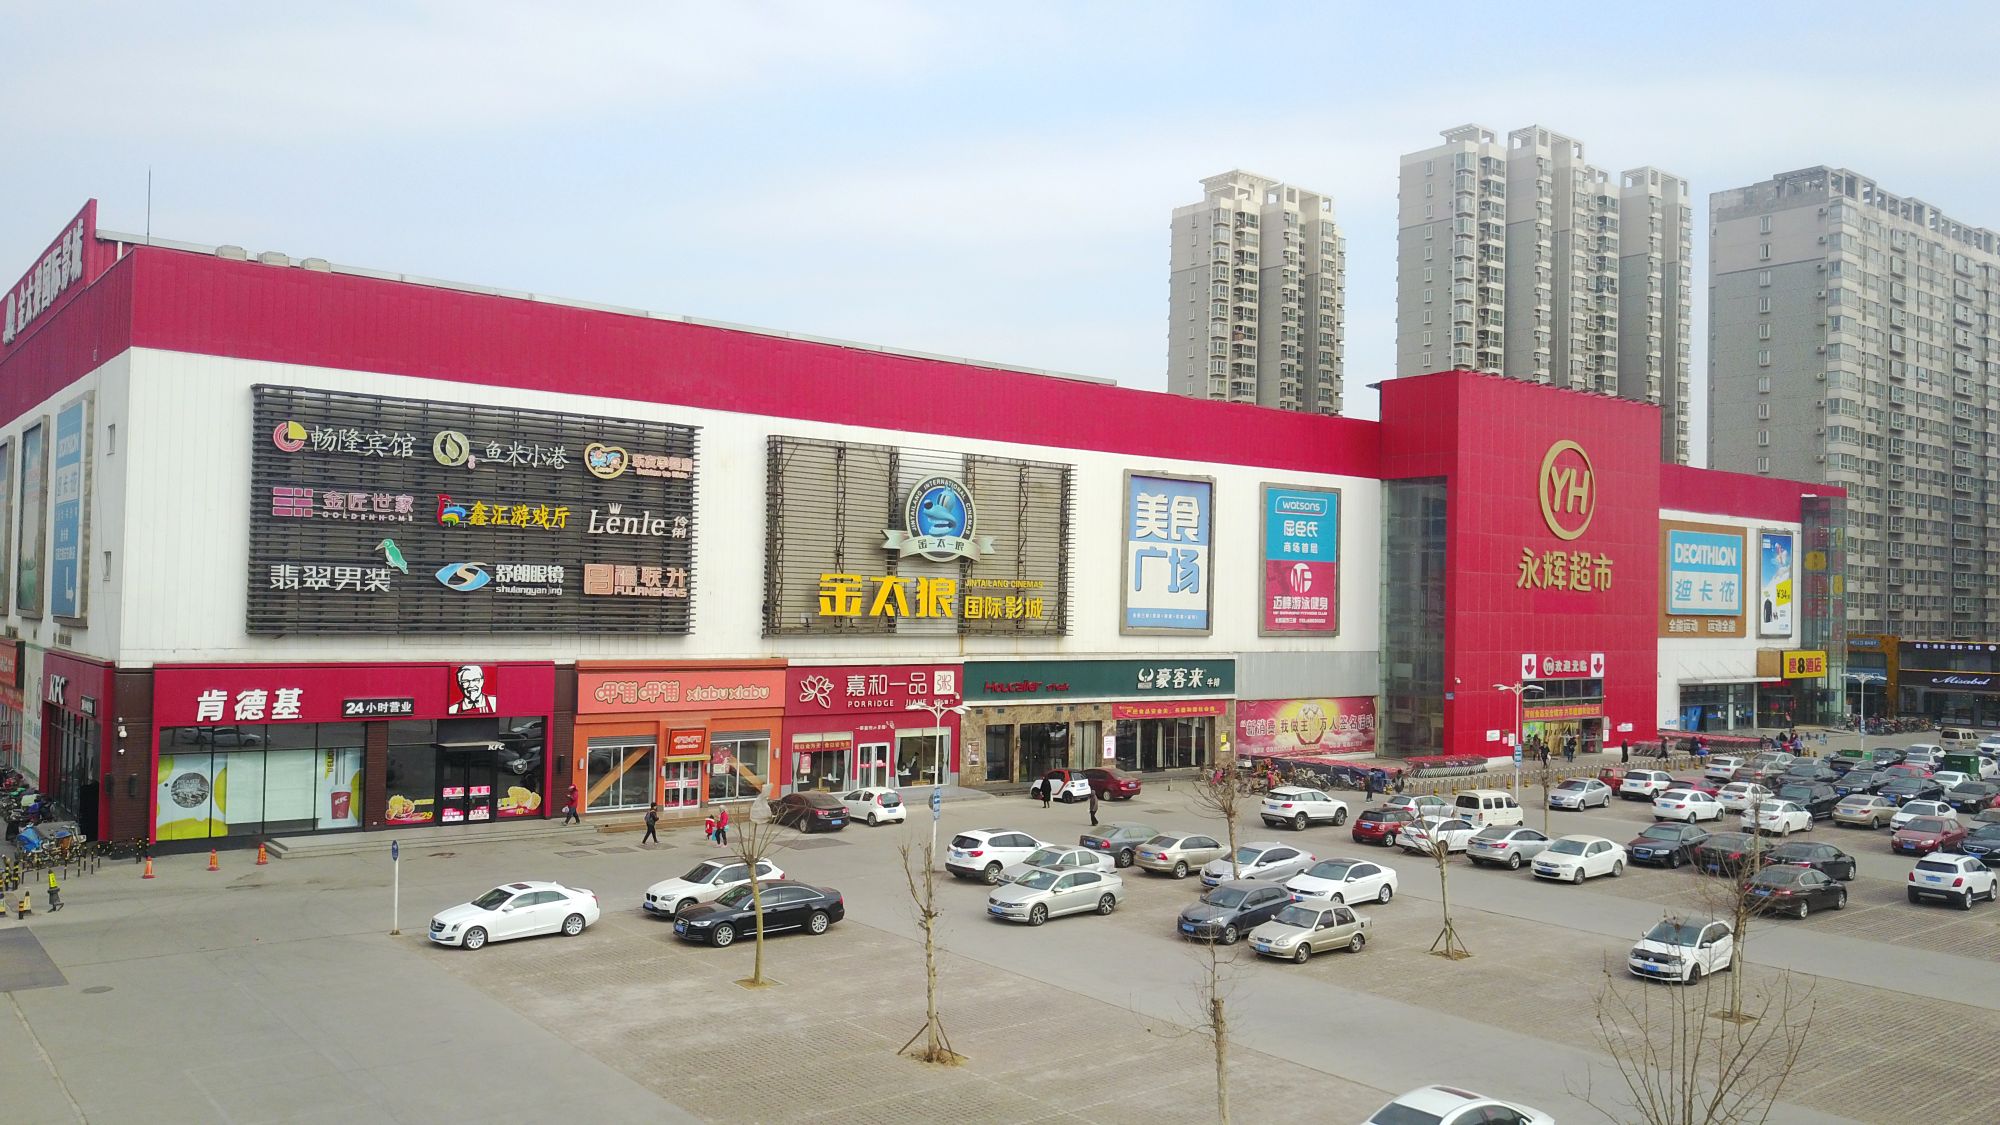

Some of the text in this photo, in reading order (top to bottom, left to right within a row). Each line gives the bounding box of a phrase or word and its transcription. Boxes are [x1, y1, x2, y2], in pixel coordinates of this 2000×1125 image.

[311, 425, 416, 458] 畅隆宾馆
[481, 440, 570, 469] 鱼米小港
[322, 491, 414, 513] 金匠世家
[1551, 466, 1591, 515] YH
[468, 500, 571, 530] 鑫汇游戏厅
[1135, 492, 1200, 542] 美食
[1282, 500, 1321, 511] watsons
[1284, 520, 1318, 537] 屈臣氏
[1674, 543, 1737, 567] DECATHLON
[270, 564, 391, 592] 翡翠男装
[496, 564, 565, 584] 舒朗眼镜
[614, 565, 688, 587] 福联升
[1135, 547, 1200, 594] 广场
[1517, 547, 1614, 592] 永辉超市
[818, 573, 957, 619] 金太狼
[965, 579, 1044, 589] JINTAILANG CINEMAS
[1675, 579, 1736, 603] 迪卡侬
[964, 596, 1043, 620] 国际影城
[48, 673, 66, 705] KFC
[846, 672, 928, 697] 嘉和一品
[1156, 668, 1204, 689] 豪客来
[595, 681, 680, 703] 呷哺呷哺
[687, 685, 770, 701] xiabu xiabu
[196, 688, 304, 722] 肯德基
[345, 701, 412, 714] 24小时营业
[488, 742, 505, 751] KFC
[334, 795, 348, 805] KFC
